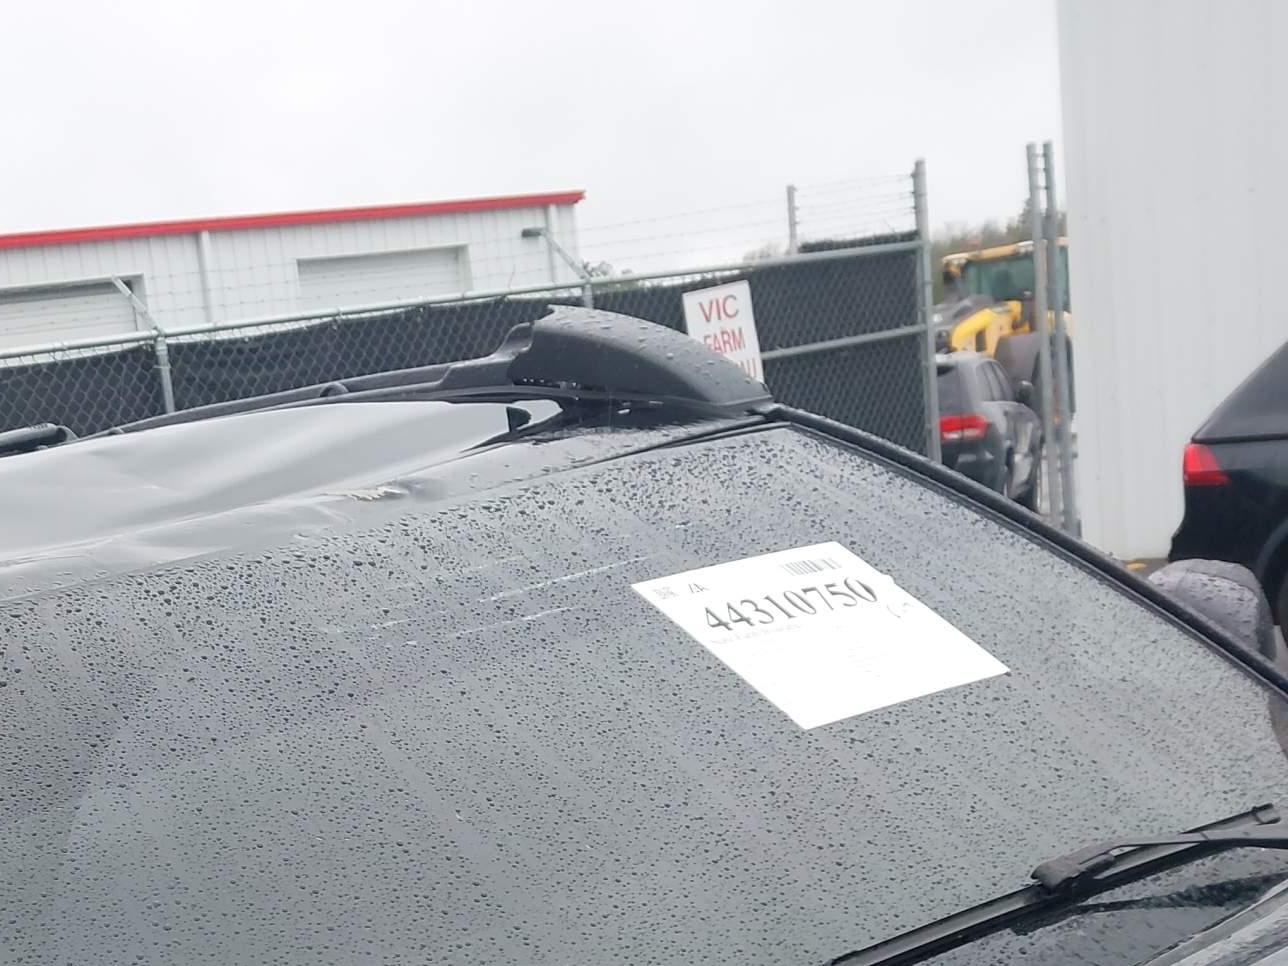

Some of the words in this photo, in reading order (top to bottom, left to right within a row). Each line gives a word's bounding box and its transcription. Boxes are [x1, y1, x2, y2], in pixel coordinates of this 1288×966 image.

[698, 294, 739, 322] VIC
[703, 327, 746, 353] FARM
[704, 576, 879, 632] 44310750
